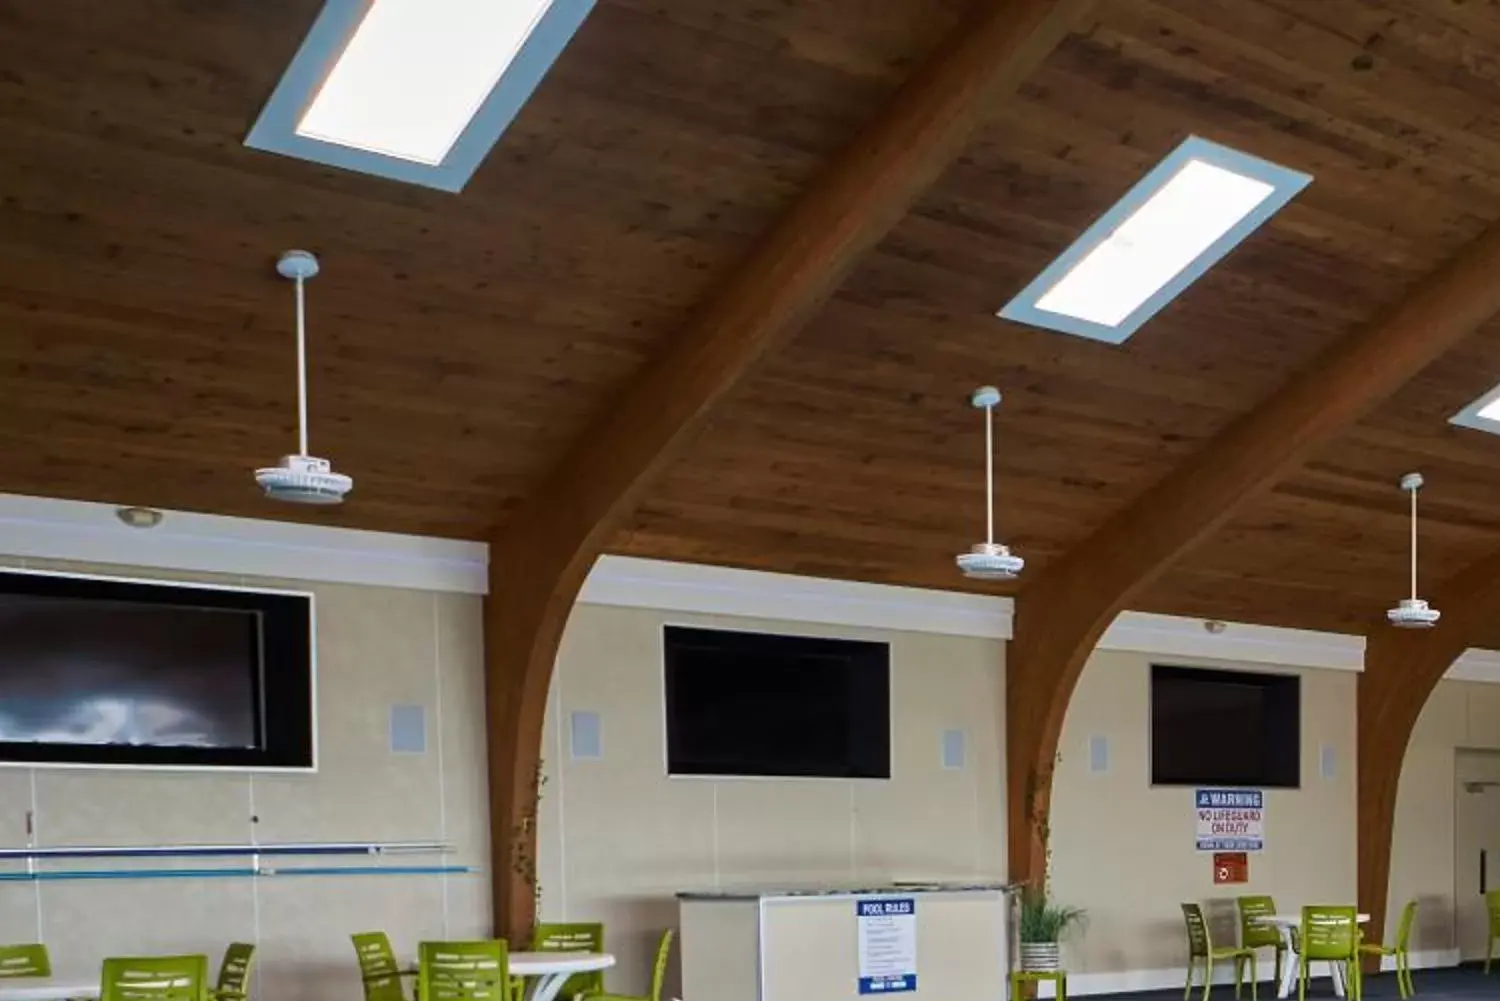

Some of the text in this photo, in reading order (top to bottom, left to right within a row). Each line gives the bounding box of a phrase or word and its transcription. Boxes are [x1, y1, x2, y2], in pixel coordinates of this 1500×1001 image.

[1210, 793, 1260, 806] WARNING
[1199, 811, 1262, 821] NO LIFEGUARD
[863, 902, 911, 914] POOL RULES
